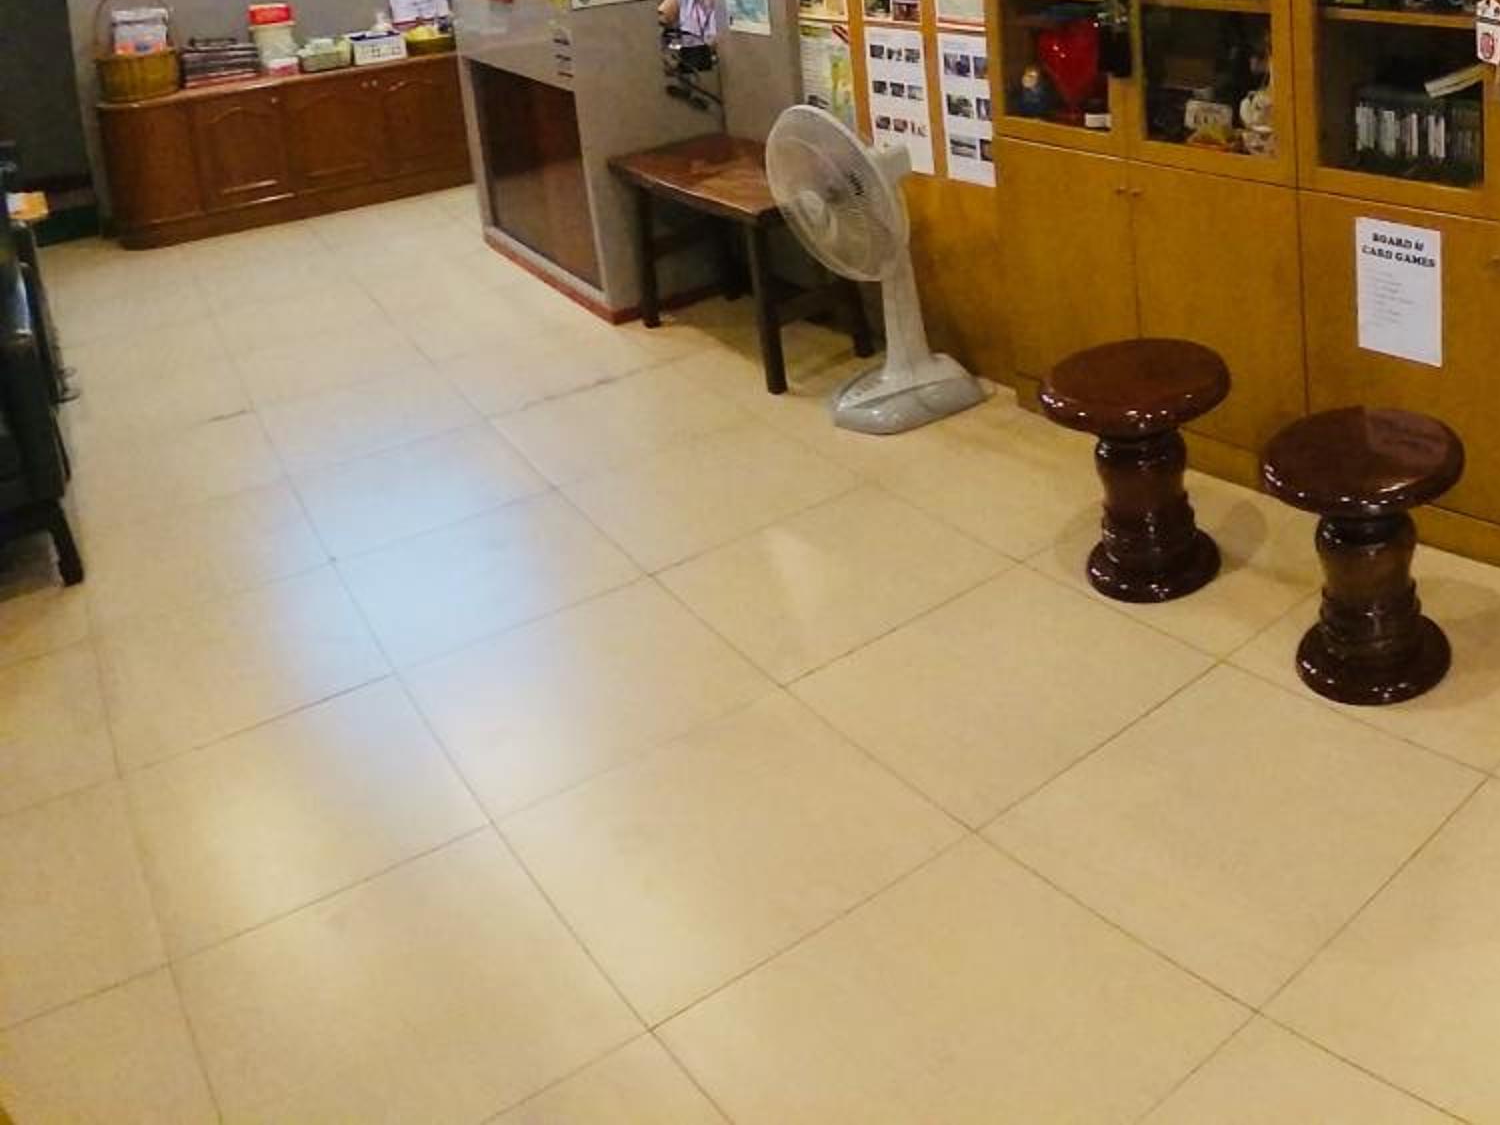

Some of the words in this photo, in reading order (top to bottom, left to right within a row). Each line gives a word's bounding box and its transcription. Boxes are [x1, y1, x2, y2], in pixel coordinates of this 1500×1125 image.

[1372, 232, 1413, 250] BOARD
[1361, 245, 1393, 260] CARD
[1395, 252, 1436, 268] GAMES
